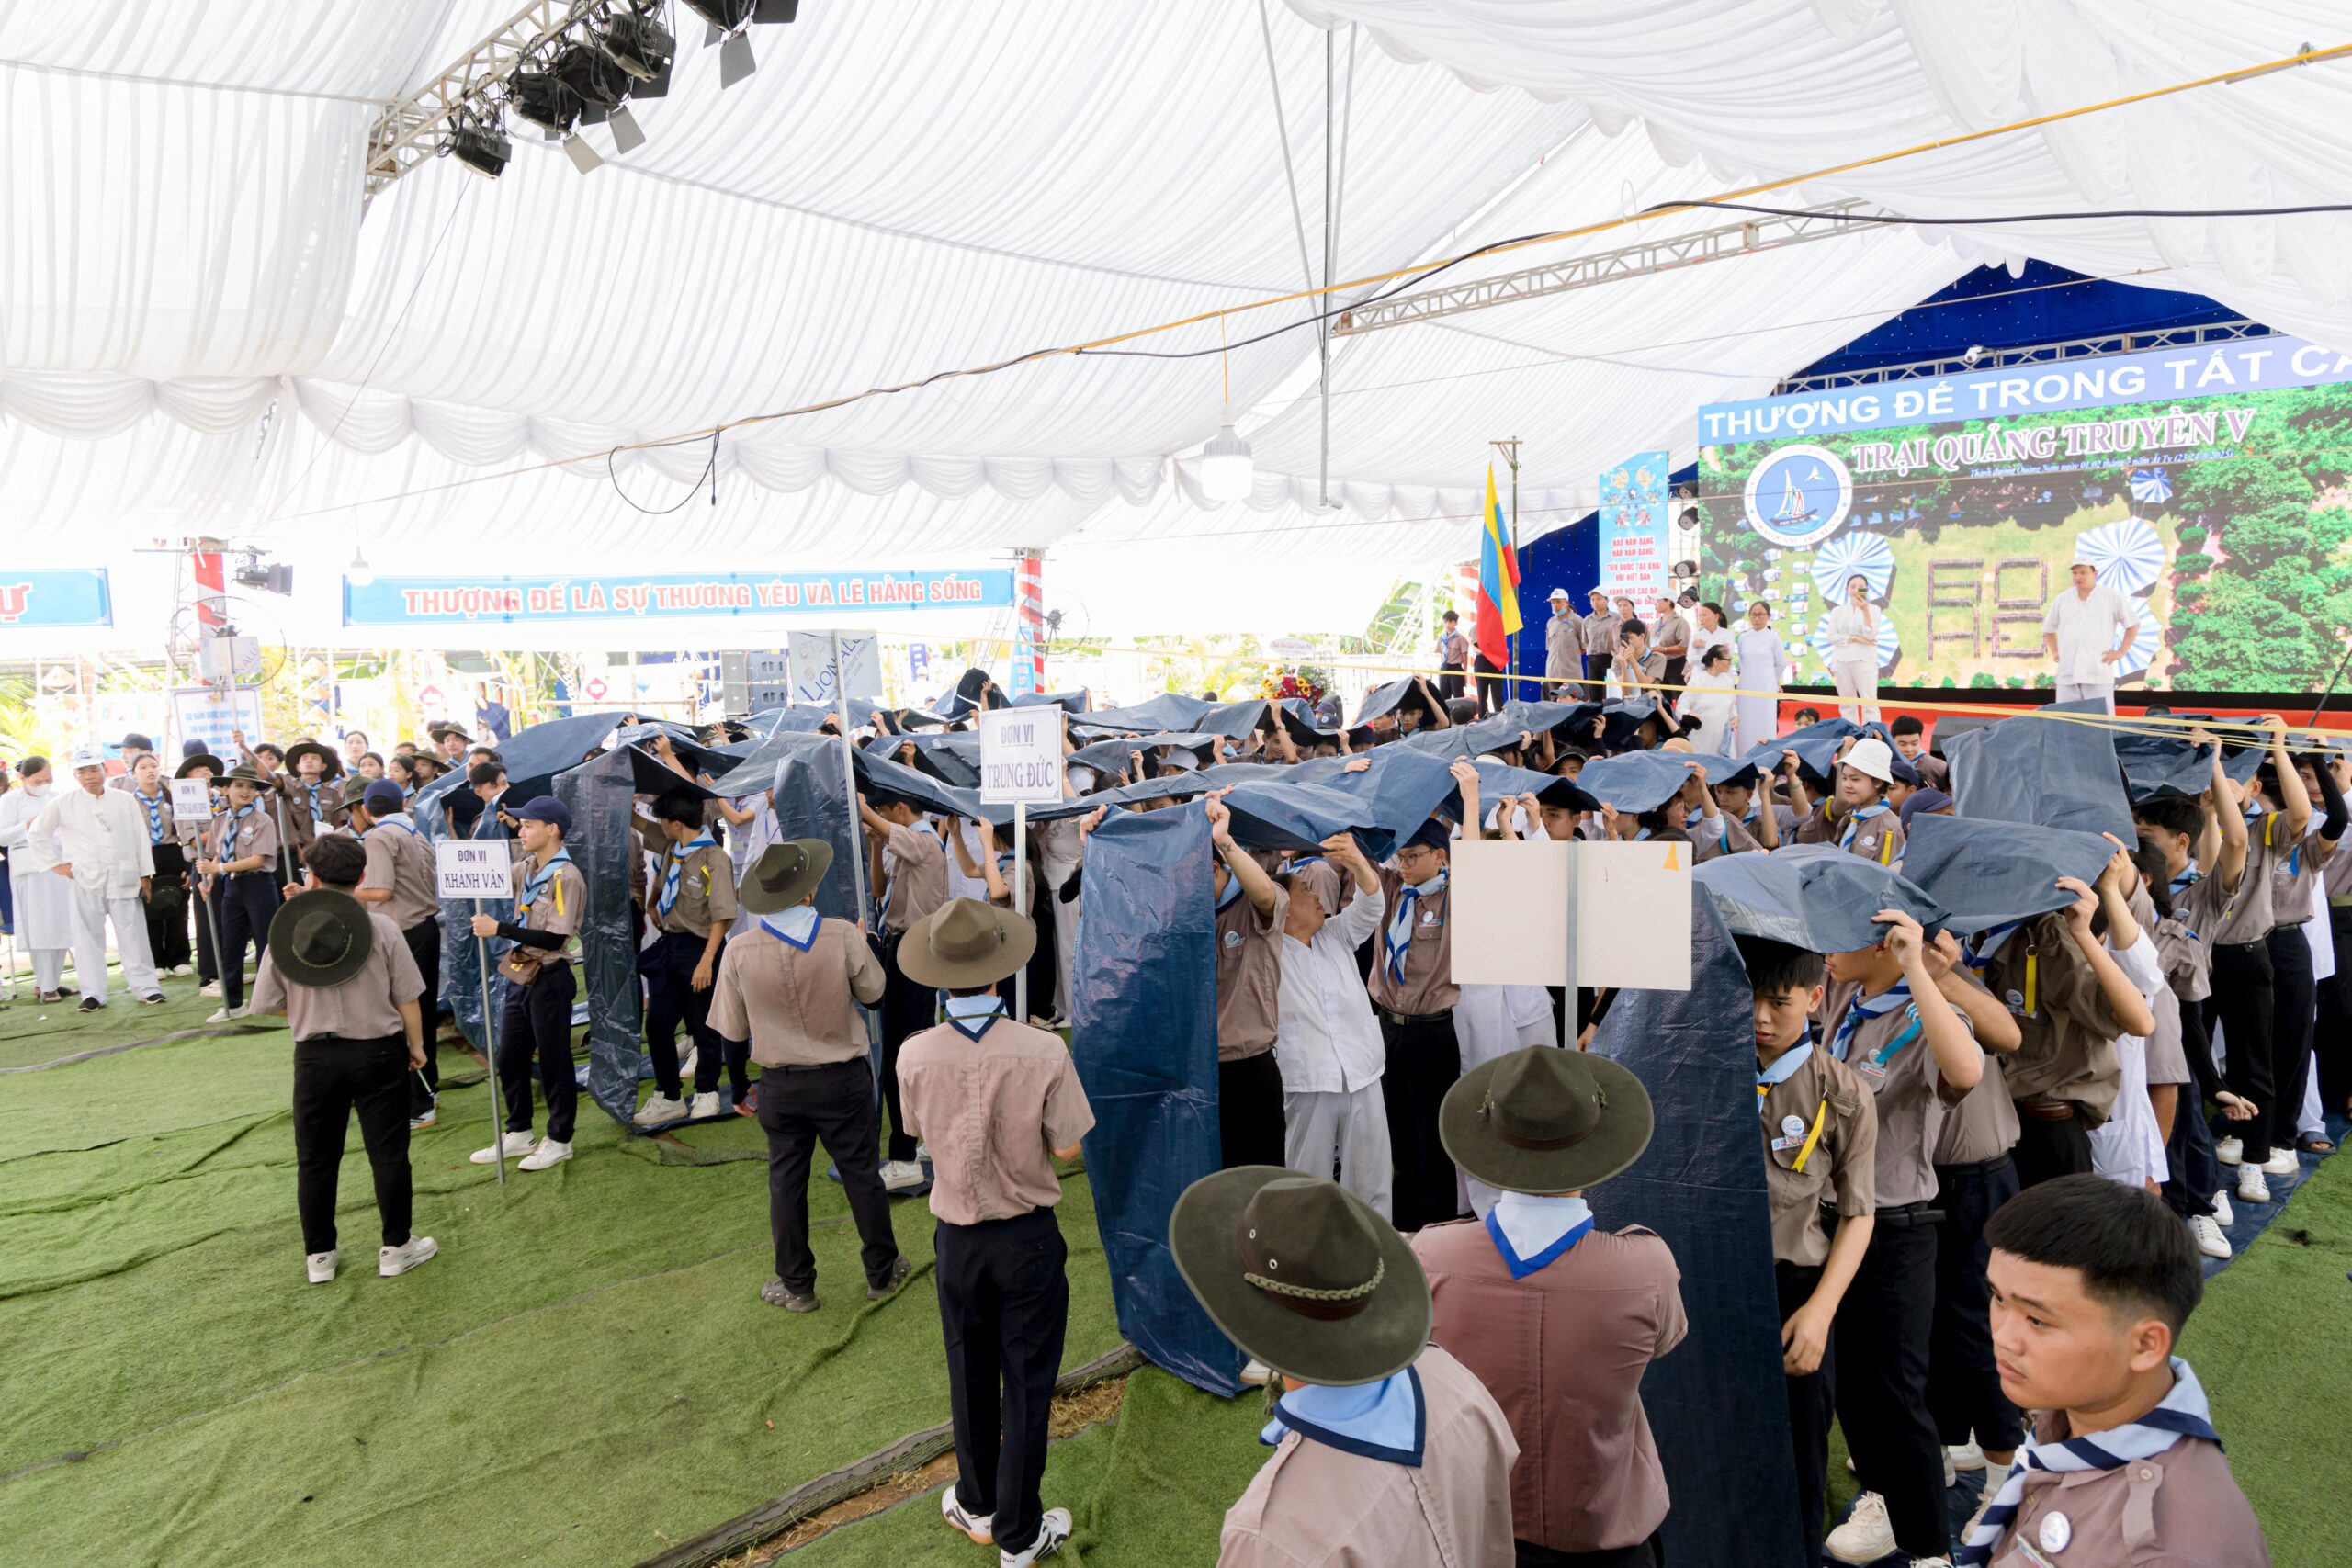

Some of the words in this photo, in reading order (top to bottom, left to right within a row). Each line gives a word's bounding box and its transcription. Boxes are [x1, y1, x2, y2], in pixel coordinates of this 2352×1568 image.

[1704, 396, 1880, 438] THƯỢNG
[1894, 381, 1954, 418] ĐẾ
[1970, 366, 2146, 411] TRONG
[2165, 347, 2273, 389] TẤT
[1852, 438, 1928, 477] TRẠI
[1933, 423, 2057, 471] QUẢNG
[2063, 406, 2218, 455] TRUYỀN
[2223, 408, 2256, 443] V
[404, 587, 521, 617] THƯỢNG
[529, 581, 568, 611] ĐẾ
[574, 584, 605, 610] LÀ
[615, 585, 649, 613] SỰ
[656, 583, 750, 608] THƯƠNG
[757, 581, 798, 604] YÊU
[807, 580, 834, 604] VÀ
[840, 580, 863, 603] LẼ
[870, 575, 923, 603] HẰNG
[930, 575, 981, 601] SỐNG
[1001, 724, 1021, 745] ĐƠN
[1023, 723, 1034, 747] VỊ
[987, 762, 1023, 789] TRUNG
[1026, 754, 1054, 788] ĐỨC
[458, 849, 476, 862] ĐƠN
[478, 850, 487, 863] VỊ
[444, 869, 480, 888] KHÁNH
[481, 869, 504, 888] VÂN
